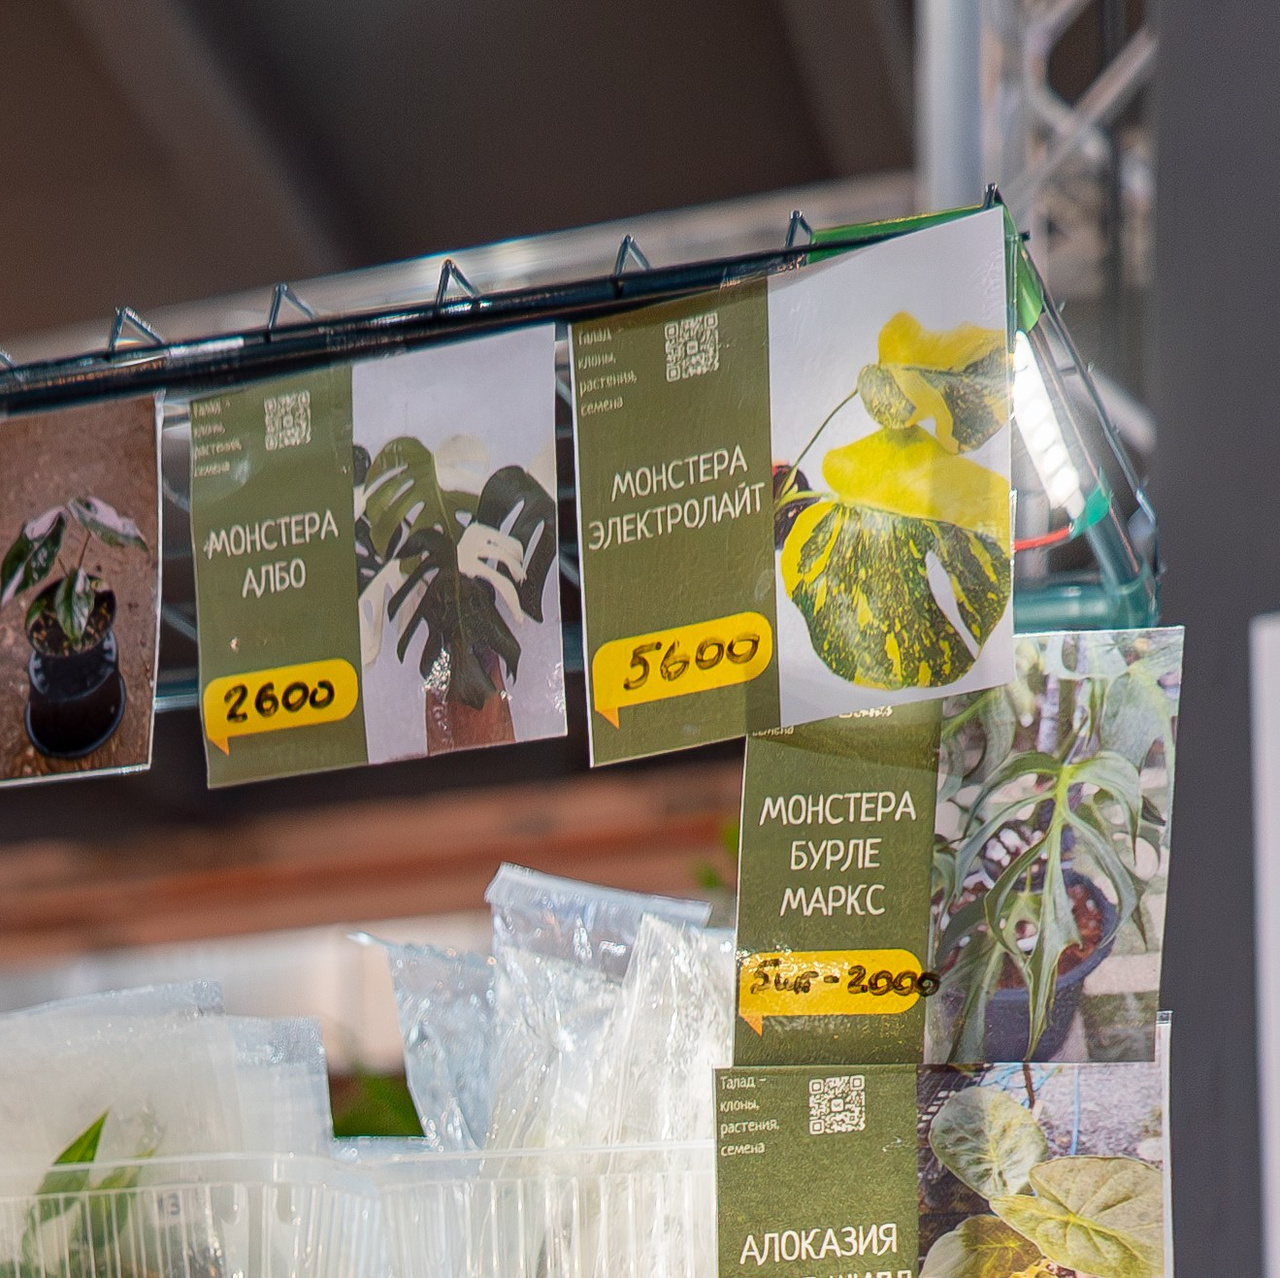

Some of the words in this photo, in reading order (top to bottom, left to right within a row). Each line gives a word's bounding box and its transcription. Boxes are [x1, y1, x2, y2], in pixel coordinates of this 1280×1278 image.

[612, 444, 748, 502] МОНСТЕРА
[206, 509, 339, 559] МОНСТЕРА
[588, 482, 765, 550] ЭЛЕКТРОЛАЙТ
[242, 558, 306, 599] АЛБО
[623, 633, 760, 691] 5600
[224, 679, 336, 724] 2600
[759, 790, 917, 826] МОНСТЕРА
[790, 838, 882, 872] БУРЛЕ
[780, 884, 886, 917] МАРКС
[721, 1075, 756, 1091] Талад
[720, 1097, 760, 1113] клоны,
[721, 1118, 780, 1135] растения,
[721, 1142, 765, 1156] семена
[739, 1222, 898, 1266] АЛОКАЗИЯ
